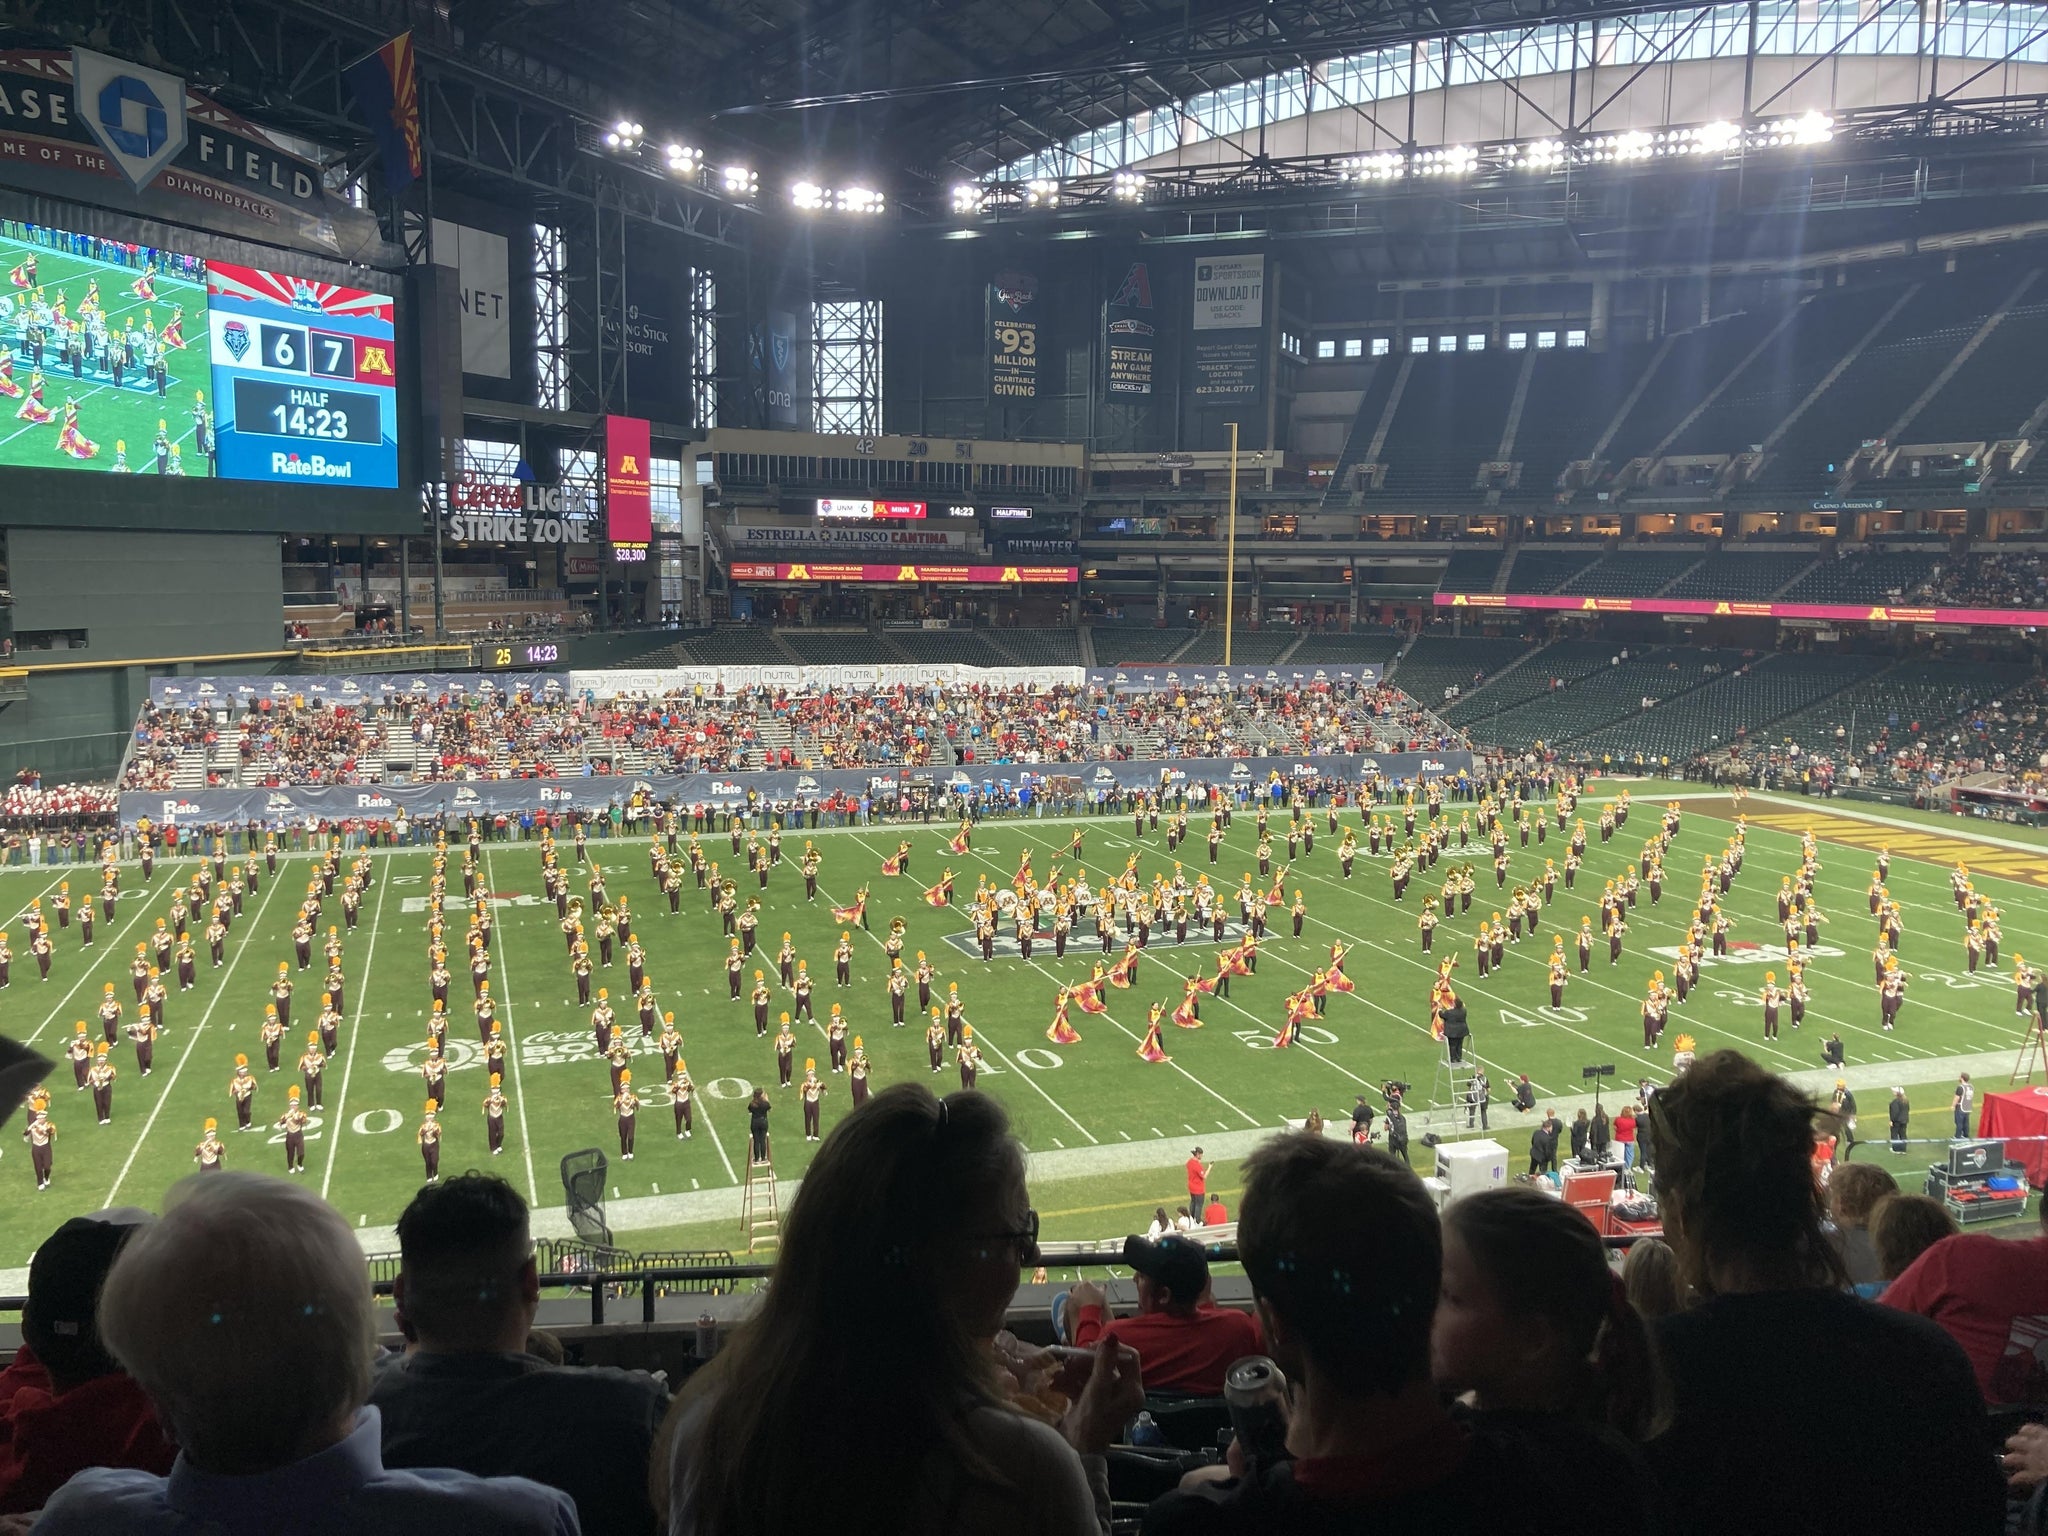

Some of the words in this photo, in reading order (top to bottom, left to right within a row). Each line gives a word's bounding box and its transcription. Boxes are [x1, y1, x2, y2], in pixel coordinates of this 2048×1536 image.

[40, 148, 62, 161] OF
[76, 154, 106, 170] THE
[200, 134, 313, 199] FIELD
[166, 175, 275, 220] DIAMONDBACKS
[1213, 270, 1261, 280] SPORTSBOOK
[1197, 286, 1248, 301] DOWNLOAD
[1252, 285, 1261, 299] IT
[994, 321, 1036, 330] CELEBRATING
[615, 335, 653, 355] ESORT
[275, 333, 295, 366] 6
[324, 340, 343, 372] 7
[1111, 350, 1152, 362] STREAM
[994, 355, 1036, 367] MILLION
[1111, 362, 1128, 370] ANY
[1130, 363, 1151, 372] GAME
[994, 376, 1035, 384] CHARITABLE
[1111, 372, 1151, 381] ANYWHERE
[994, 384, 1035, 397] GIVING
[1196, 385, 1255, 393] 623.304.0777
[291, 389, 329, 407] HALF
[274, 404, 348, 440] 14:23
[855, 438, 874, 454] 42
[908, 441, 927, 456] 20
[956, 443, 974, 459] 51
[272, 452, 351, 478] RateBowl
[453, 469, 524, 510] Coors
[527, 486, 587, 513] LIGHT
[861, 503, 868, 514] 6
[914, 504, 922, 514] 7
[949, 506, 974, 517] 14:23
[996, 509, 1028, 517] HALFTIME
[1813, 502, 1840, 510] CASINO
[450, 515, 528, 542] STRIKE
[532, 518, 590, 544] ZONE
[747, 528, 817, 541] ESTRELLA
[834, 530, 888, 544] JALISCO
[891, 531, 948, 545] CANTINA
[616, 548, 646, 562] $28,300
[496, 648, 511, 665] 25
[527, 645, 558, 662] 14:23
[764, 671, 796, 680] NUTRL
[845, 670, 875, 679] NUTRL
[1294, 764, 1319, 775] Rate
[1422, 760, 1445, 771] Rate
[712, 781, 742, 795] Rate
[871, 776, 898, 790] Rate
[358, 793, 392, 808] Rate
[540, 787, 573, 801] Rate
[163, 800, 200, 815] Rate
